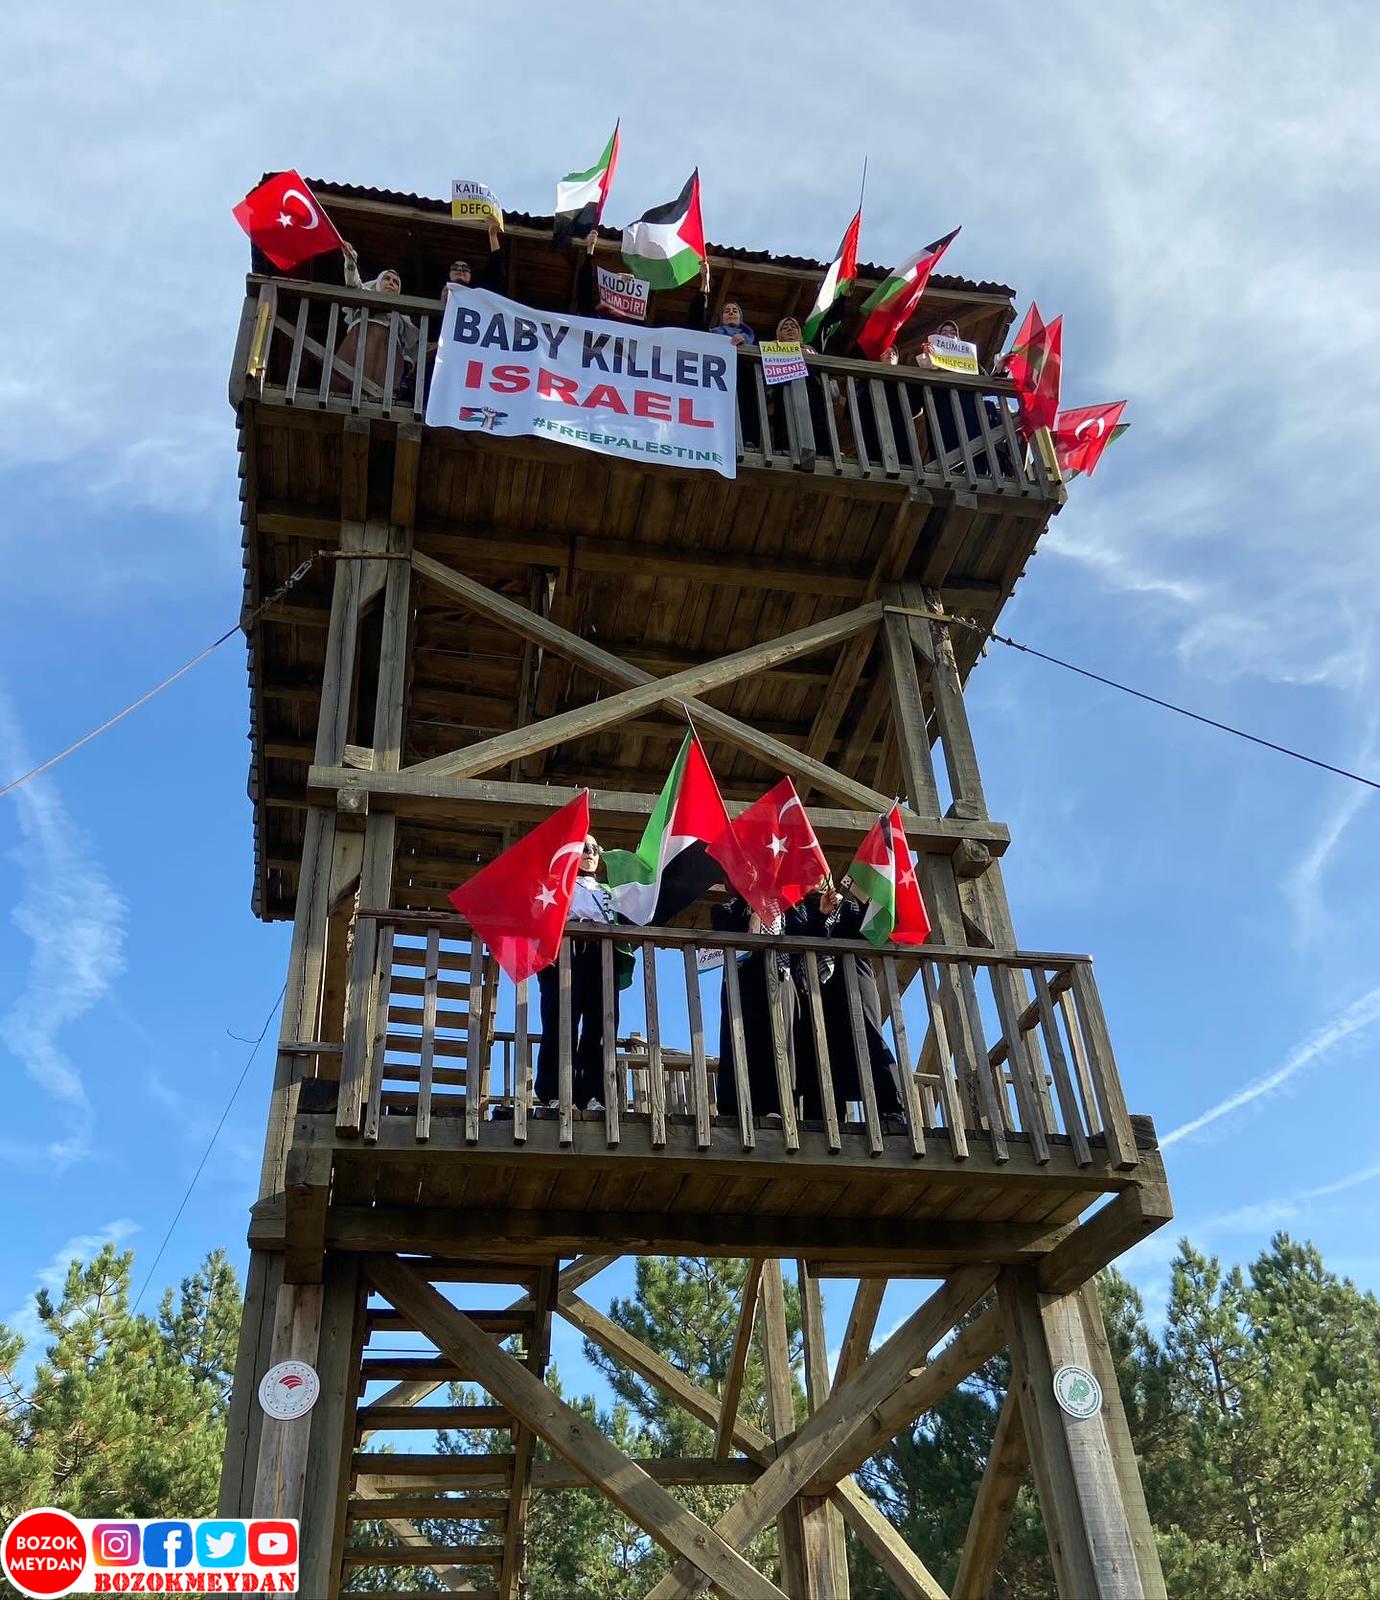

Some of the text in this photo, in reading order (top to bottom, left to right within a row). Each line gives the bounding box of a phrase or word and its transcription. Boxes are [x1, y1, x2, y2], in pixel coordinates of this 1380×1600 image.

[602, 274, 643, 297] KUDÜS
[453, 307, 728, 392] BABY KILLER
[465, 360, 715, 429] ISRAEL
[532, 416, 723, 466] #FREEPALESTINE
